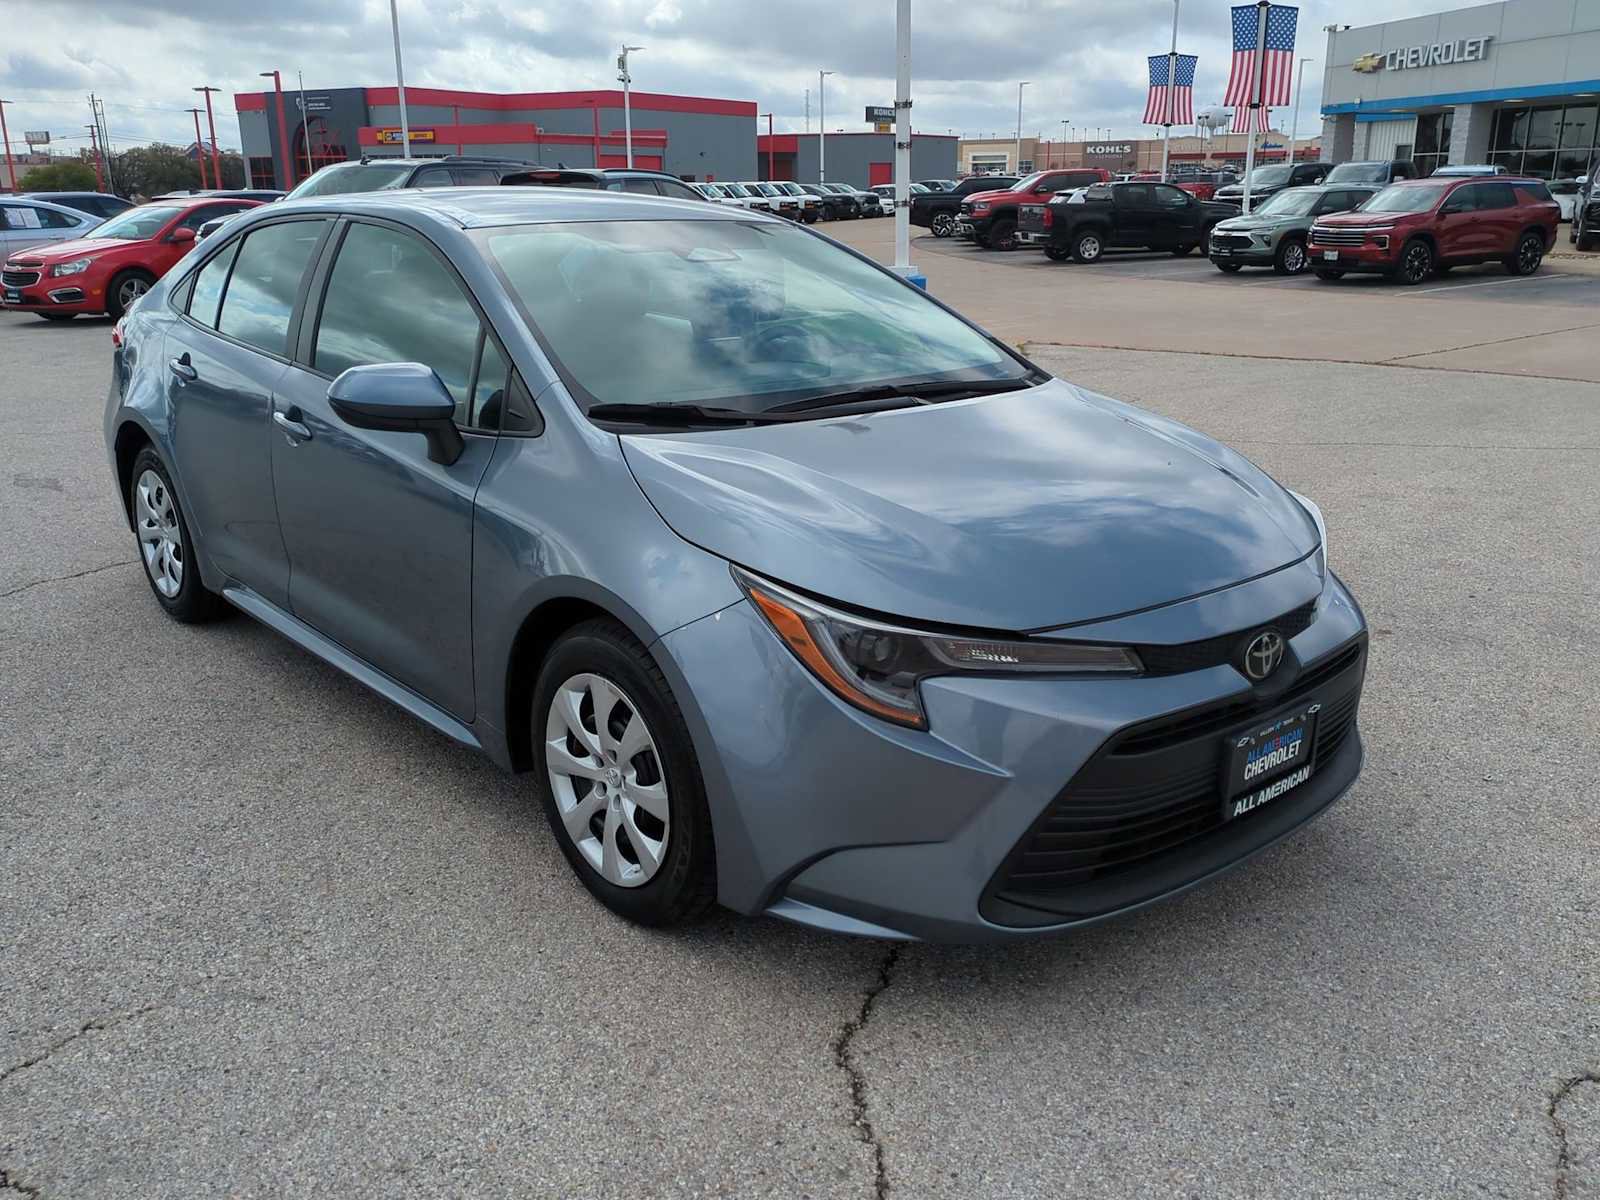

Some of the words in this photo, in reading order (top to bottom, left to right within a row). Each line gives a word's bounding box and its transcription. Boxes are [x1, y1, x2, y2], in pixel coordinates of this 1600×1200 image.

[1386, 35, 1493, 71] CHEVROLET
[1087, 144, 1131, 154] KOHL'S
[1244, 739, 1302, 780] CHEVROLET
[1233, 794, 1256, 817] ALL
[1256, 765, 1311, 807] AMERICAN
